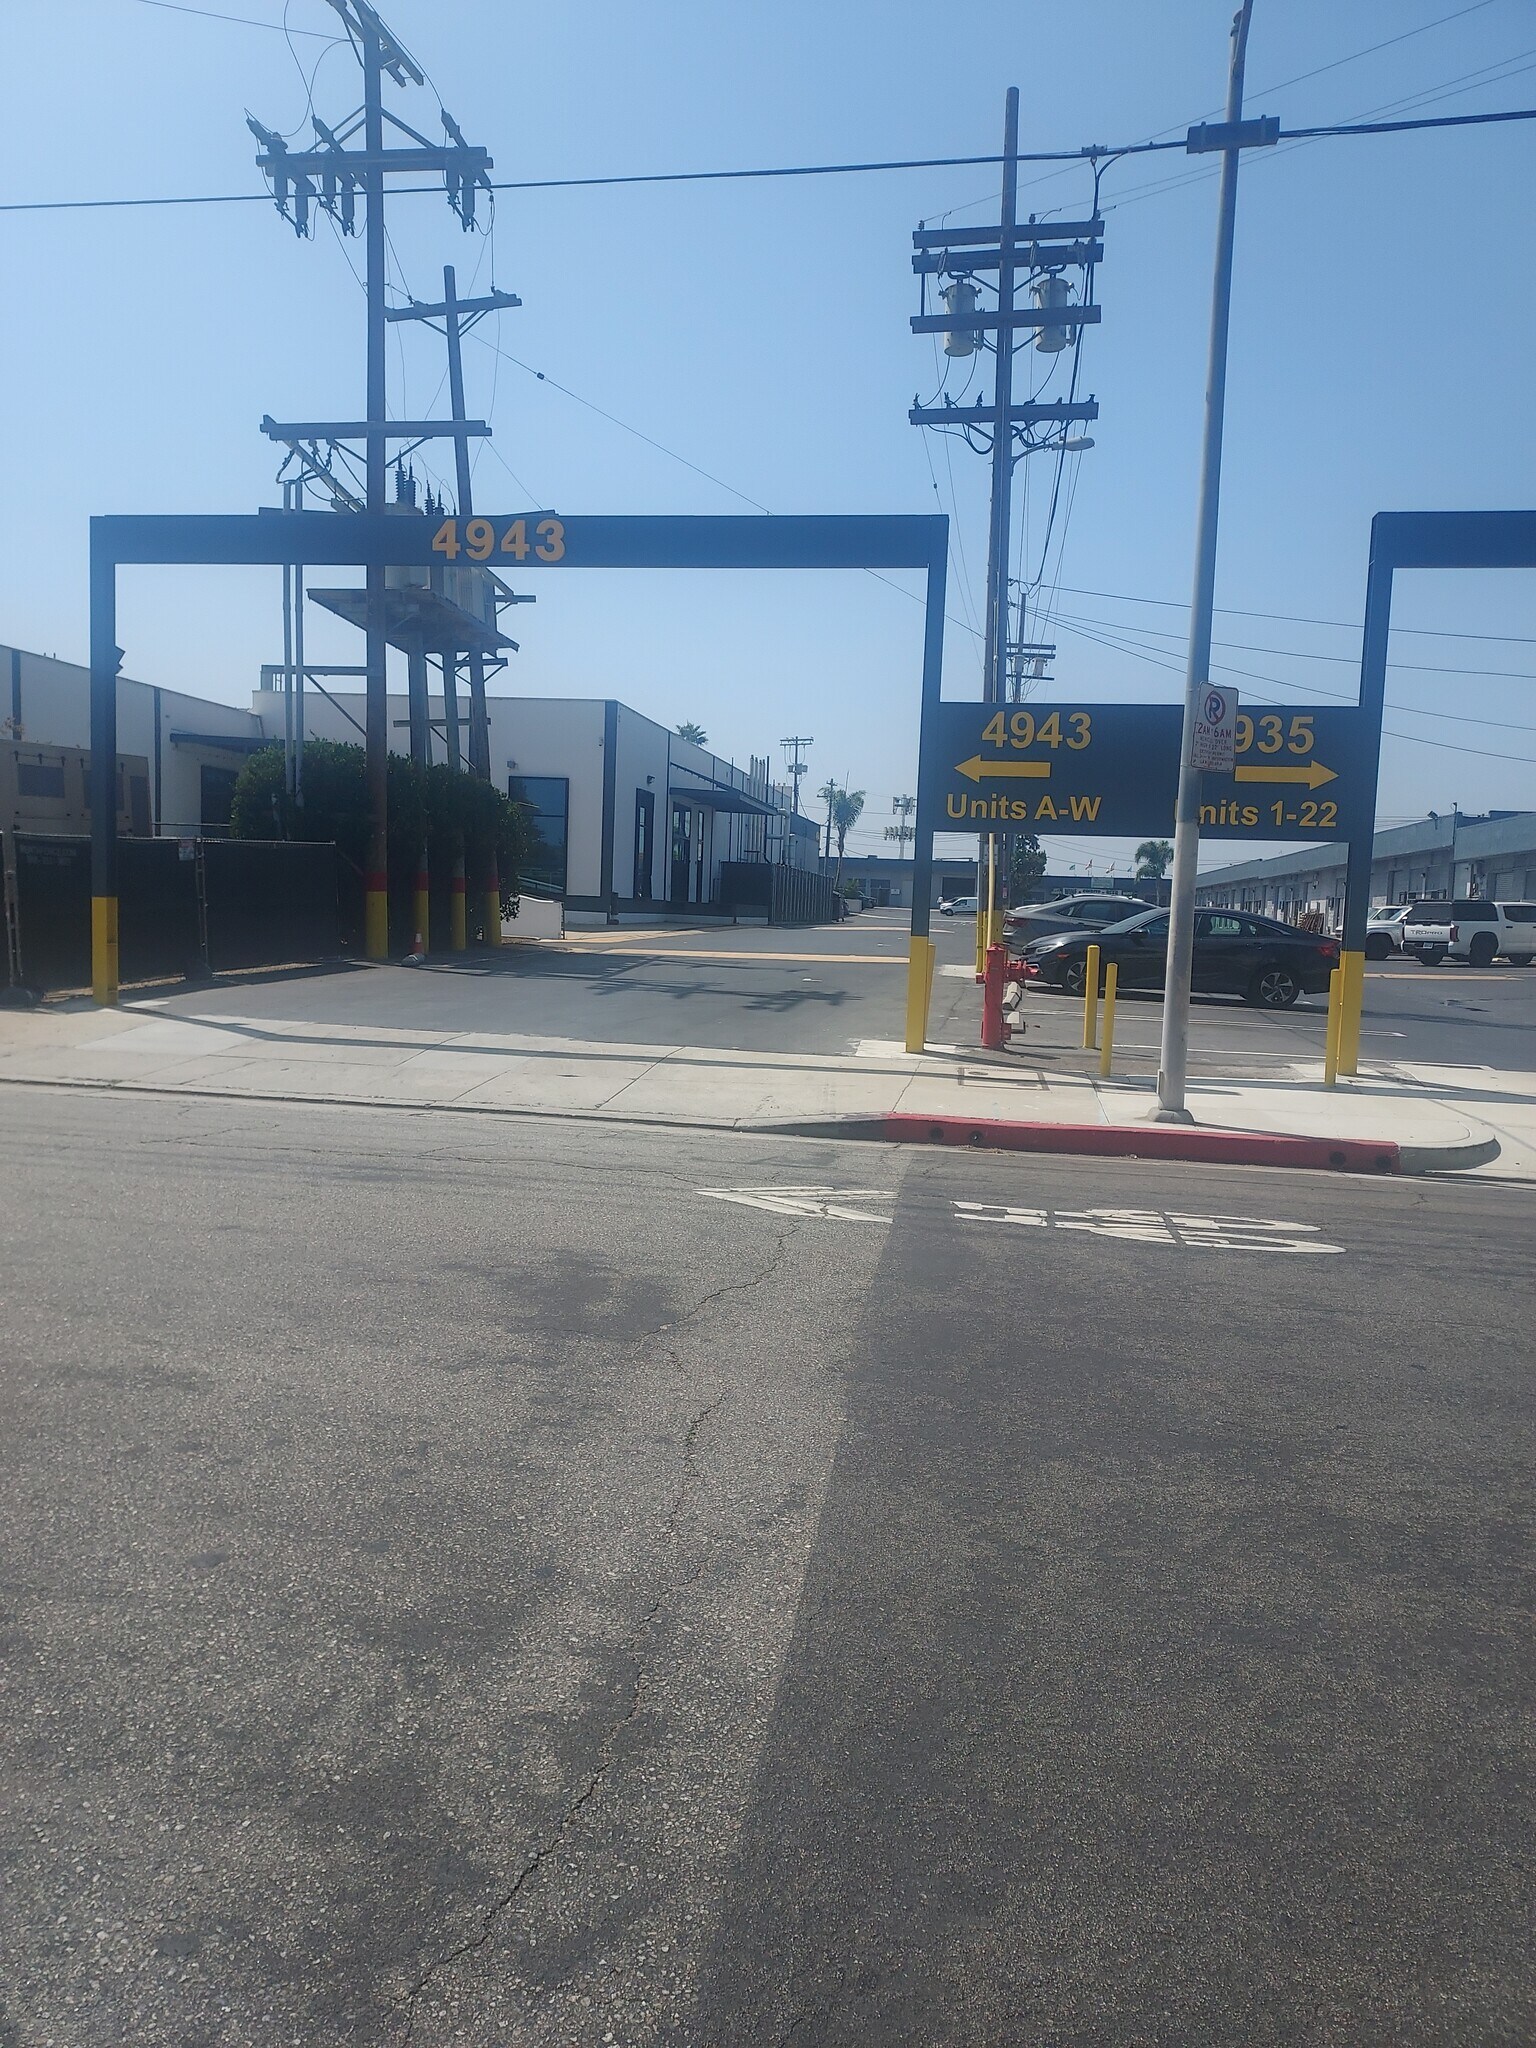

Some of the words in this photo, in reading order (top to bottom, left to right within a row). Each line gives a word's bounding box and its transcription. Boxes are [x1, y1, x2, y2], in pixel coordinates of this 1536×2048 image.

[431, 518, 566, 562] 4943
[981, 710, 1092, 750] 4943
[1235, 714, 1315, 755] 935
[946, 793, 1027, 820] Units
[1034, 795, 1102, 821] A-W
[1175, 799, 1260, 826] nits
[1269, 800, 1338, 827] 1-22
